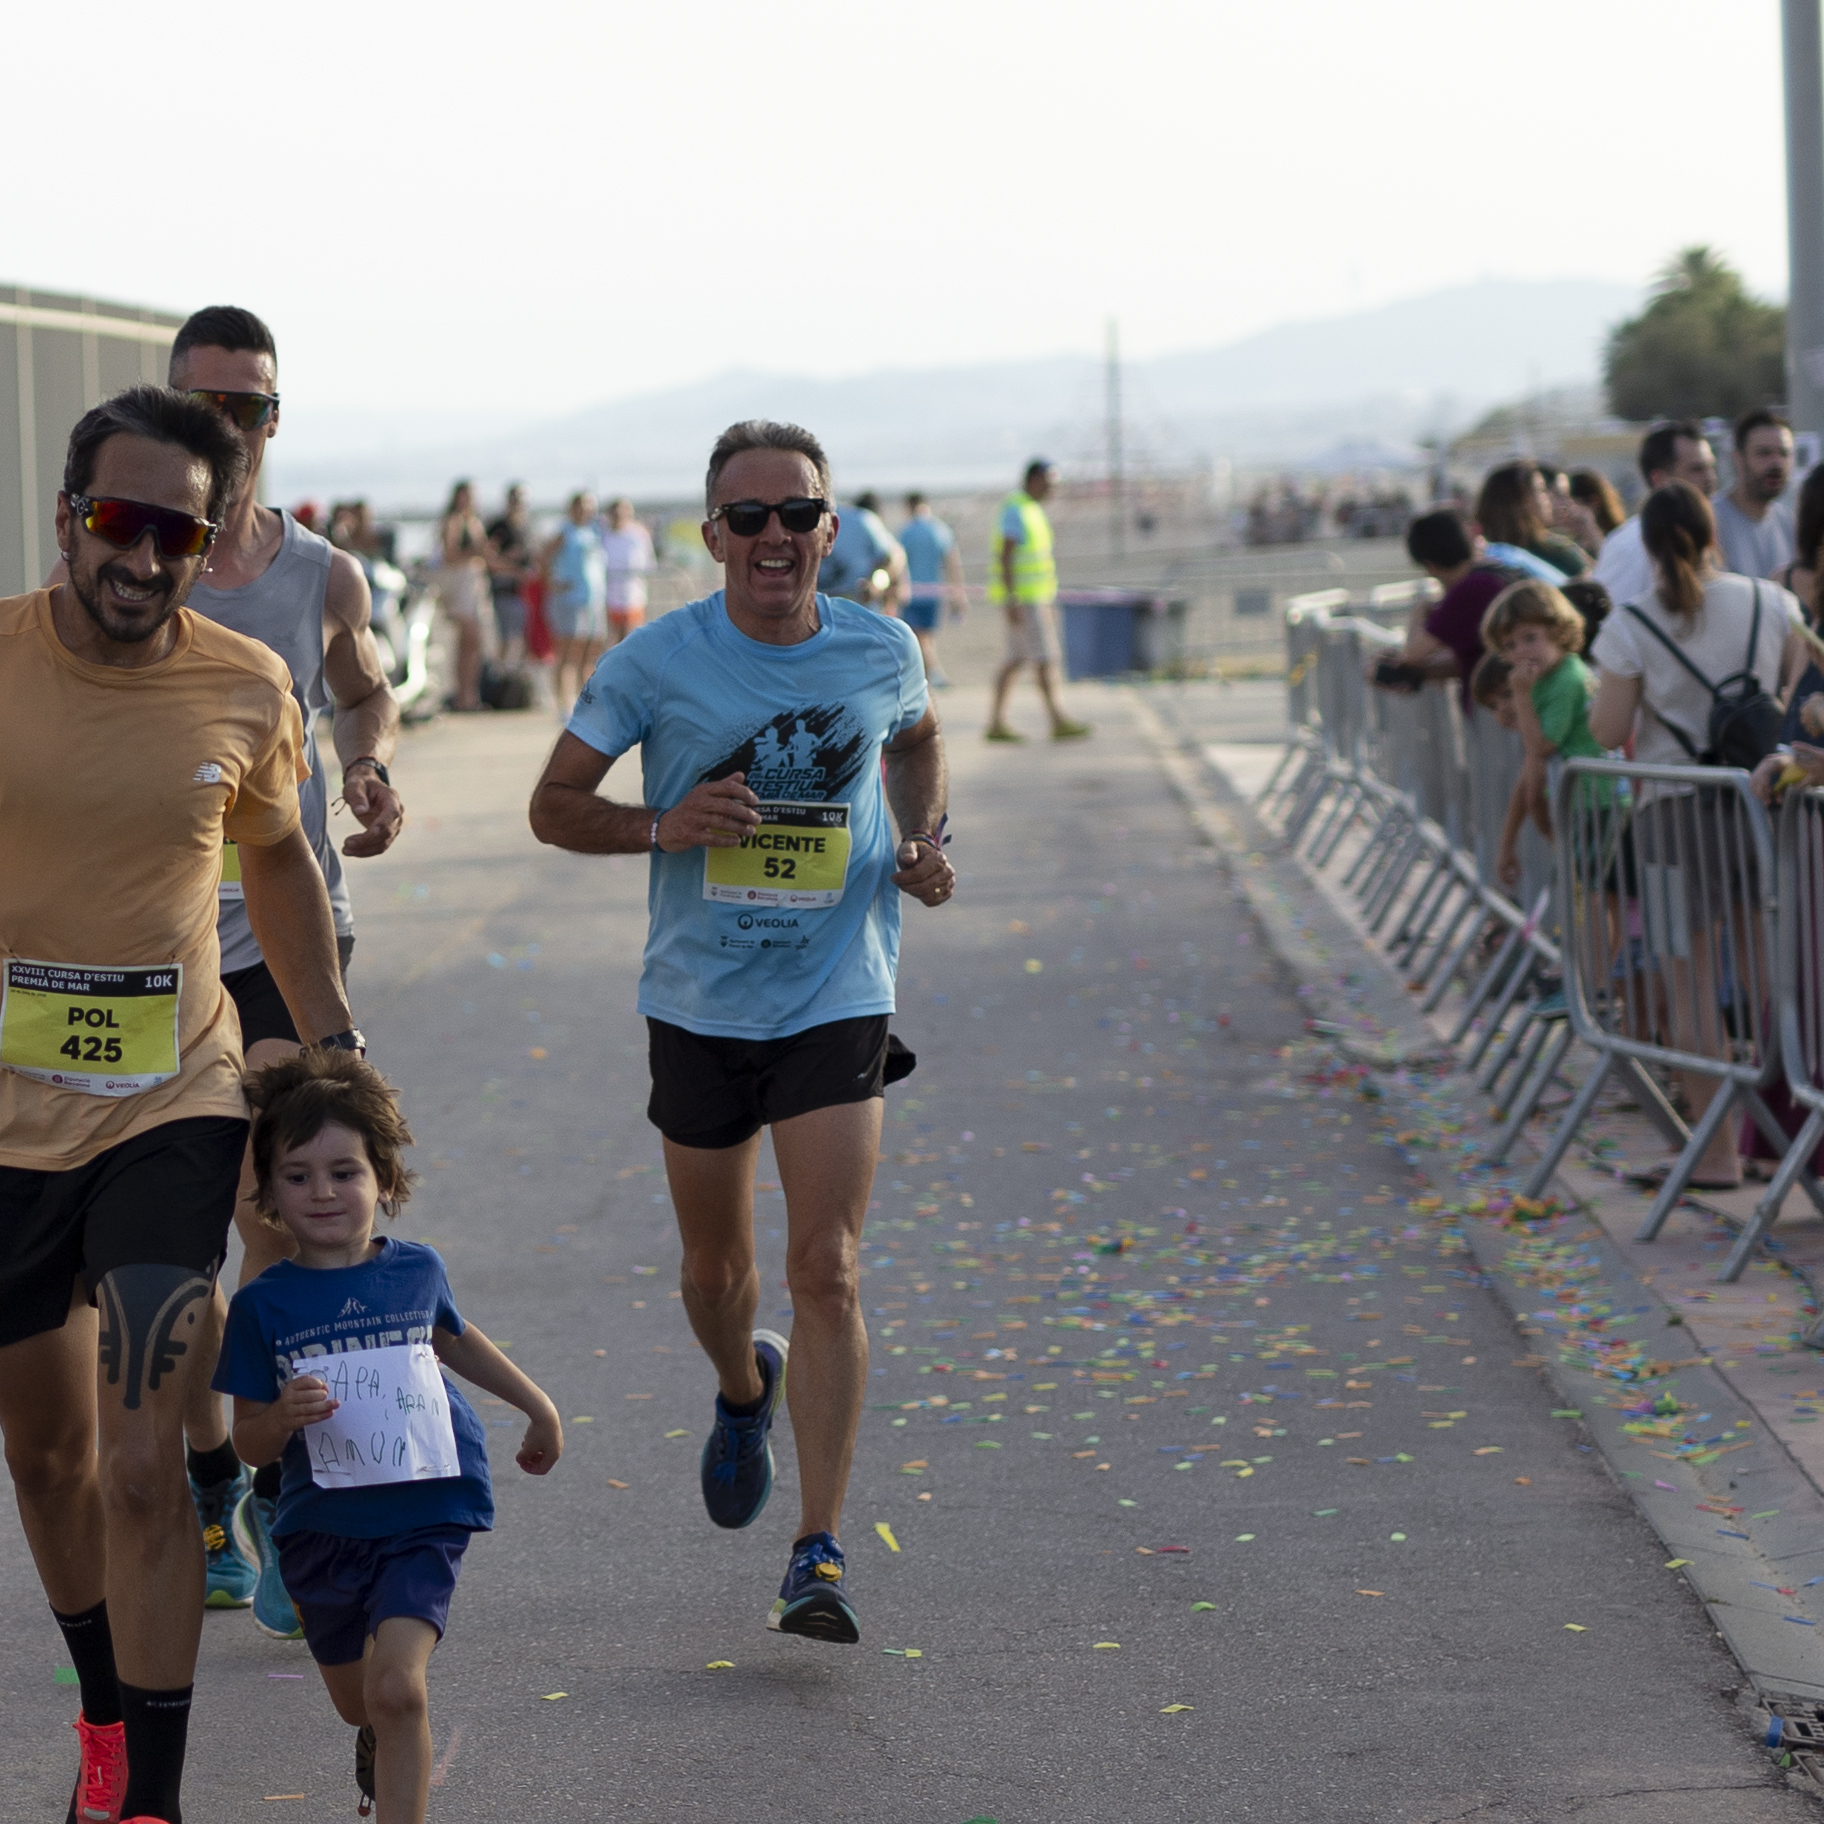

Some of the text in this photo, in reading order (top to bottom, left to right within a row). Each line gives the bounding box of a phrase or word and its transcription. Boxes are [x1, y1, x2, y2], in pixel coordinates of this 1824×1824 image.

[764, 768, 824, 780] CURSA
[773, 806, 806, 815] D'ESTIU
[822, 811, 844, 823] 10K
[739, 834, 826, 853] VICENTE
[763, 857, 796, 879] 52
[755, 918, 800, 929] VEOLIA
[11, 965, 125, 982] XXVIII CURSA D'ESTIU
[144, 974, 173, 988] 10K
[11, 975, 90, 991] PREMIÀ DE MAR
[67, 1006, 120, 1028] POL
[59, 1034, 123, 1063] 425
[284, 1324, 330, 1346] AUTHENTIC
[334, 1316, 382, 1332] MOUNTAIN
